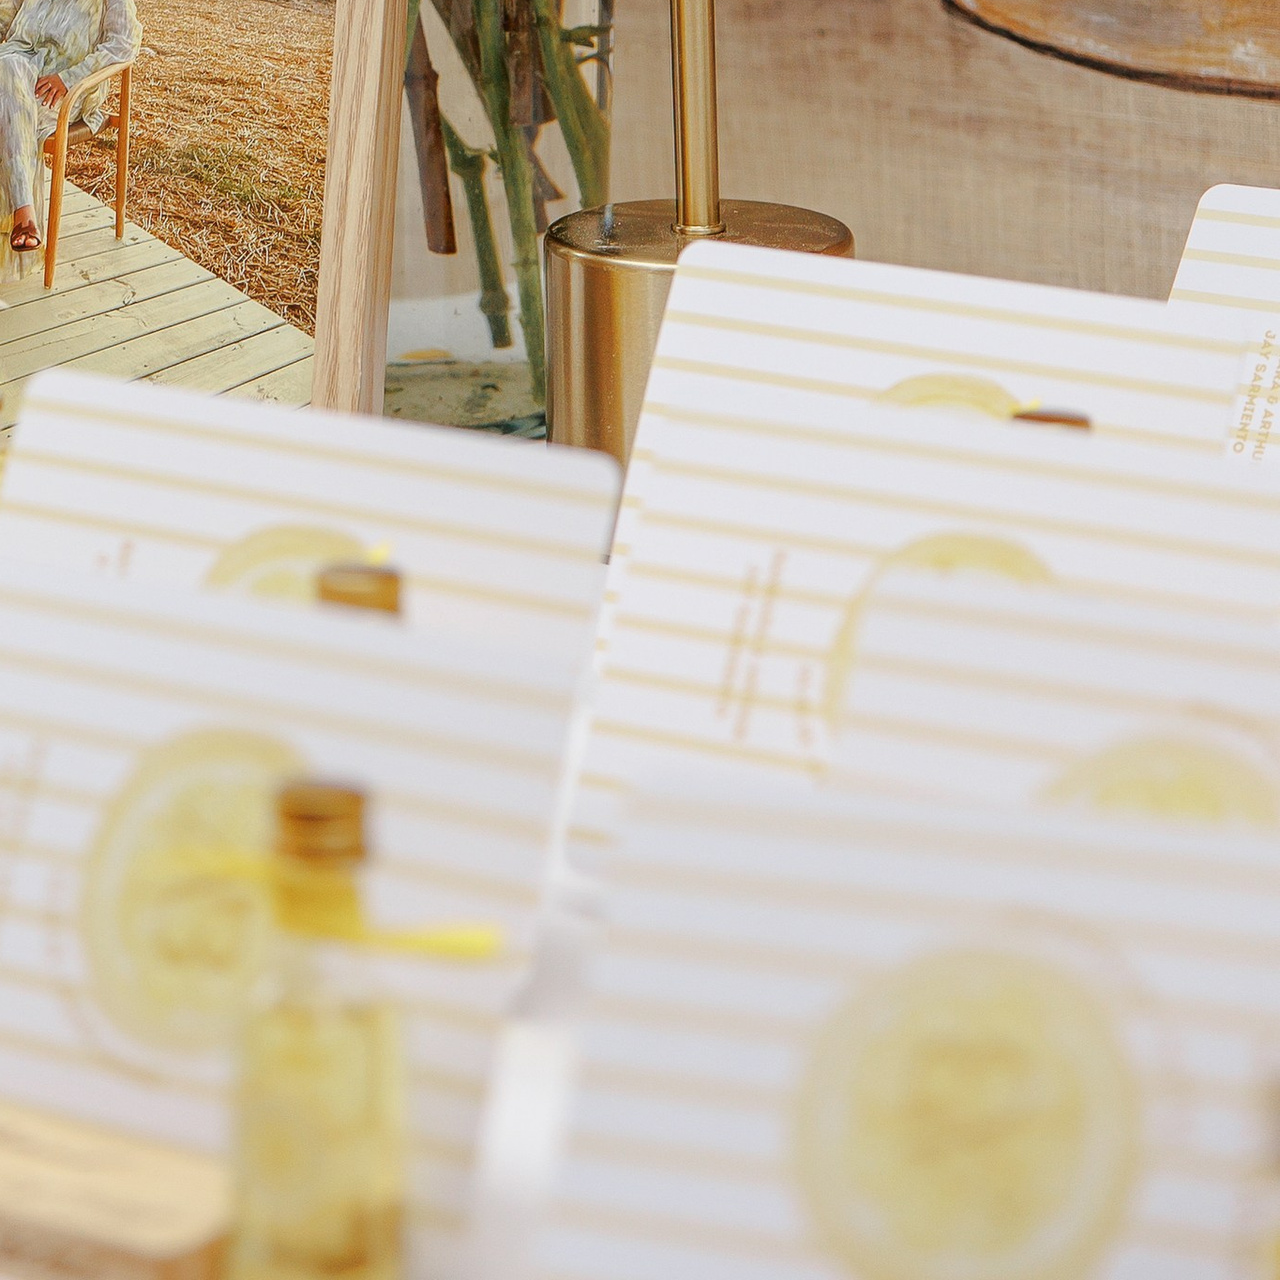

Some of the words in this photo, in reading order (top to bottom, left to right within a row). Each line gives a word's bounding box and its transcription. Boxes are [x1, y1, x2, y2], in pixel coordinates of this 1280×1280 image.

[1260, 329, 1277, 361] JAY
[1232, 363, 1268, 454] SARMIENTO
[1251, 408, 1274, 462] ARTHU
